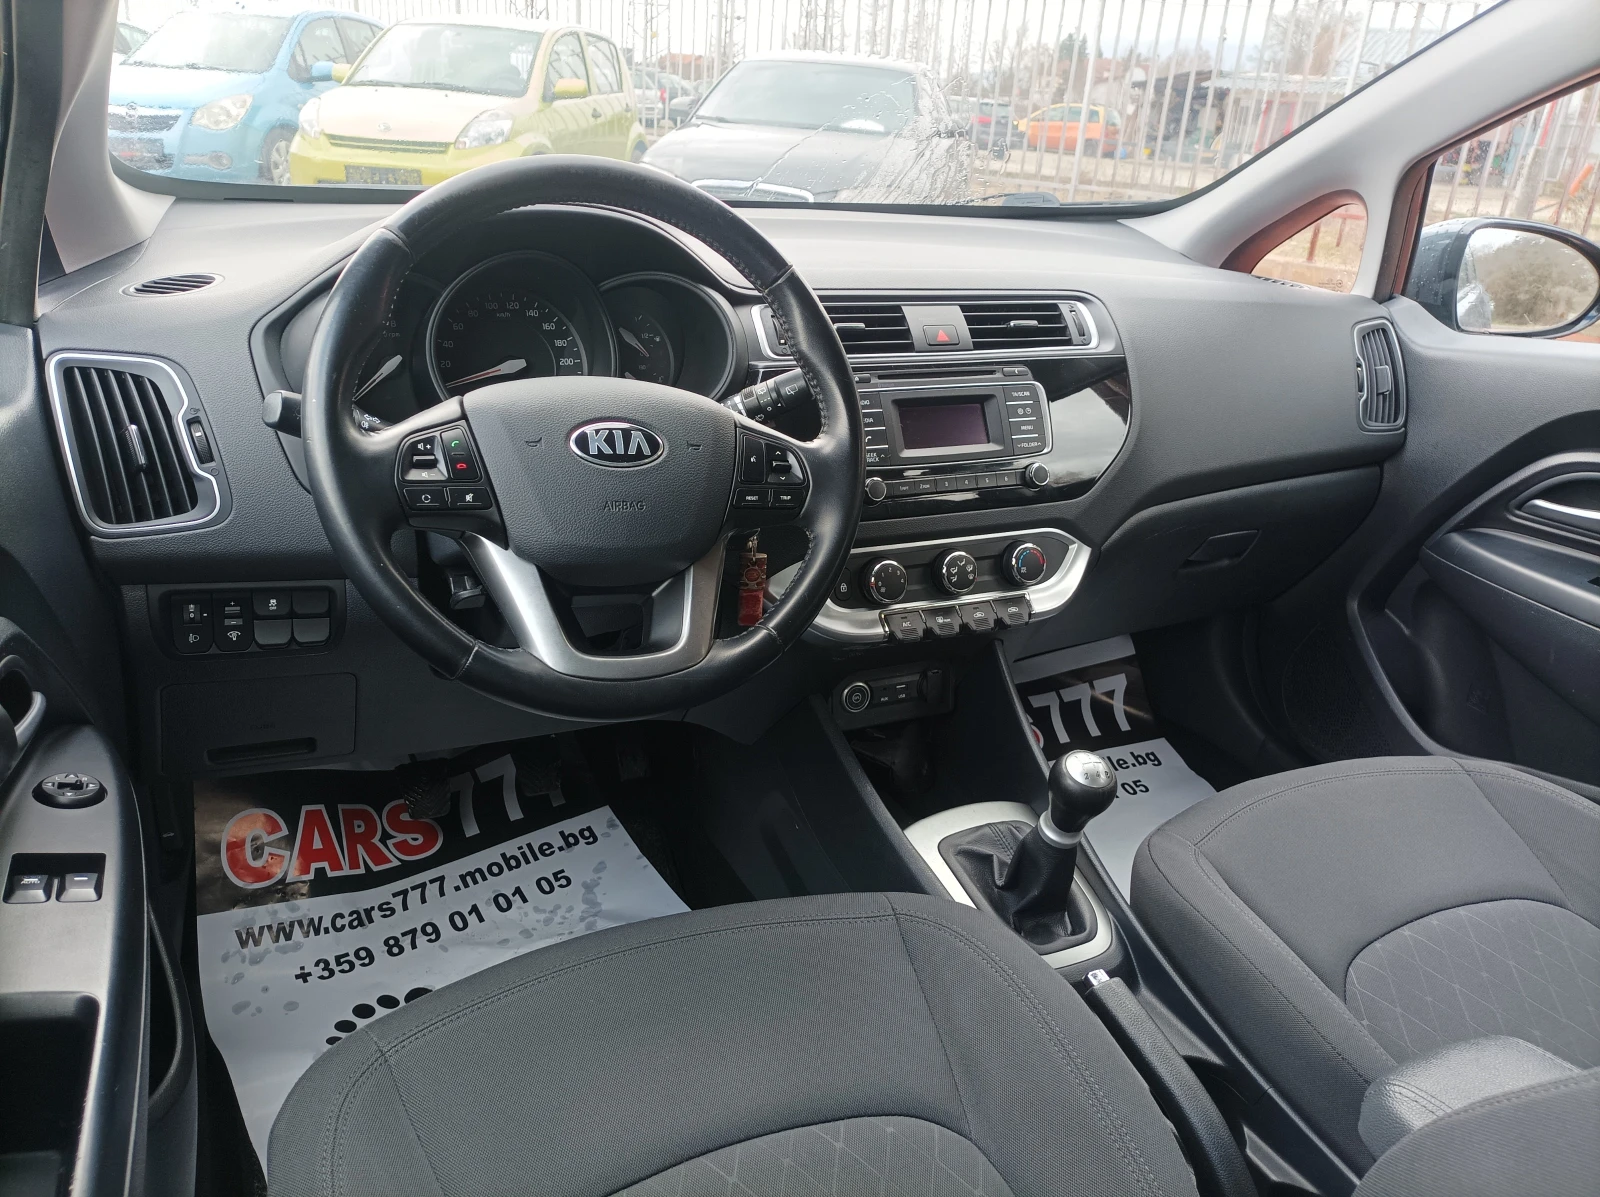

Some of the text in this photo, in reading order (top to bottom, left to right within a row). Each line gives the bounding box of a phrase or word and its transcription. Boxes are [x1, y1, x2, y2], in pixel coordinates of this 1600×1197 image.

[506, 302, 520, 310] 120
[525, 309, 539, 317] 140
[542, 322, 556, 330] 160
[442, 340, 454, 348] 40
[554, 339, 568, 347] 180
[440, 360, 452, 368] 20
[559, 358, 574, 366] 200
[584, 429, 652, 456] KIA
[603, 500, 647, 512] AIRBAG
[1120, 779, 1150, 797] 05
[220, 800, 444, 889] CARS
[235, 823, 599, 950] www.cars777.mobile.bg
[294, 868, 573, 984] +359 879 01 01 05
